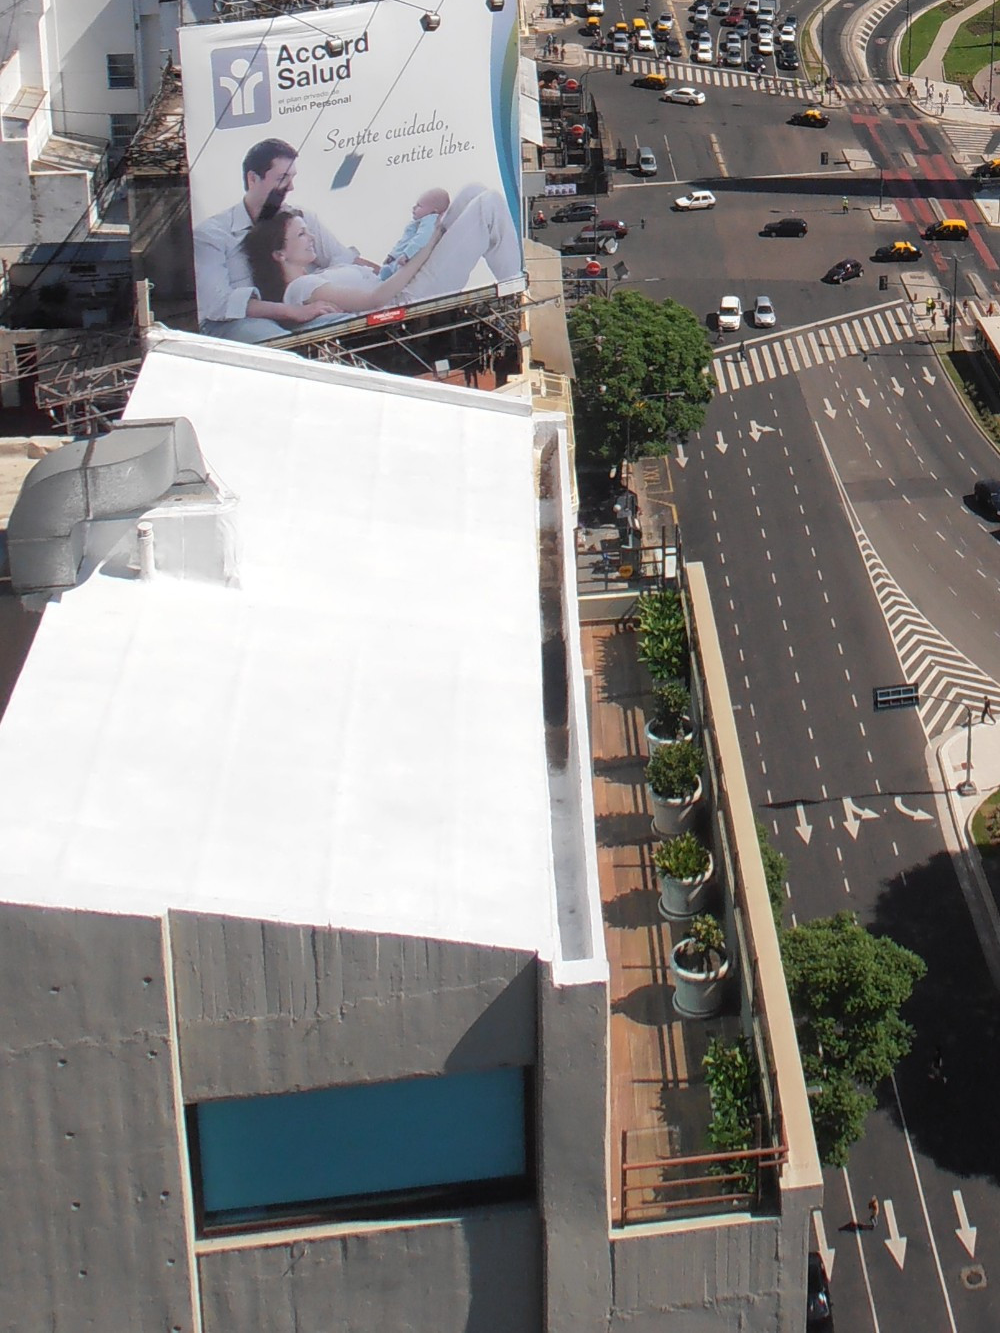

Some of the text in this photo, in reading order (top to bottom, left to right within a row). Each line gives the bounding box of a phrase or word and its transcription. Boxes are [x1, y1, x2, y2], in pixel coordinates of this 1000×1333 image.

[276, 30, 369, 66] Accrd
[277, 58, 351, 90] Salud
[278, 95, 352, 115] Unión Personal
[286, 95, 302, 104] plan
[303, 91, 329, 101] privado
[323, 109, 449, 152] Sentite cuidado,
[385, 133, 475, 167] sentite libre.
